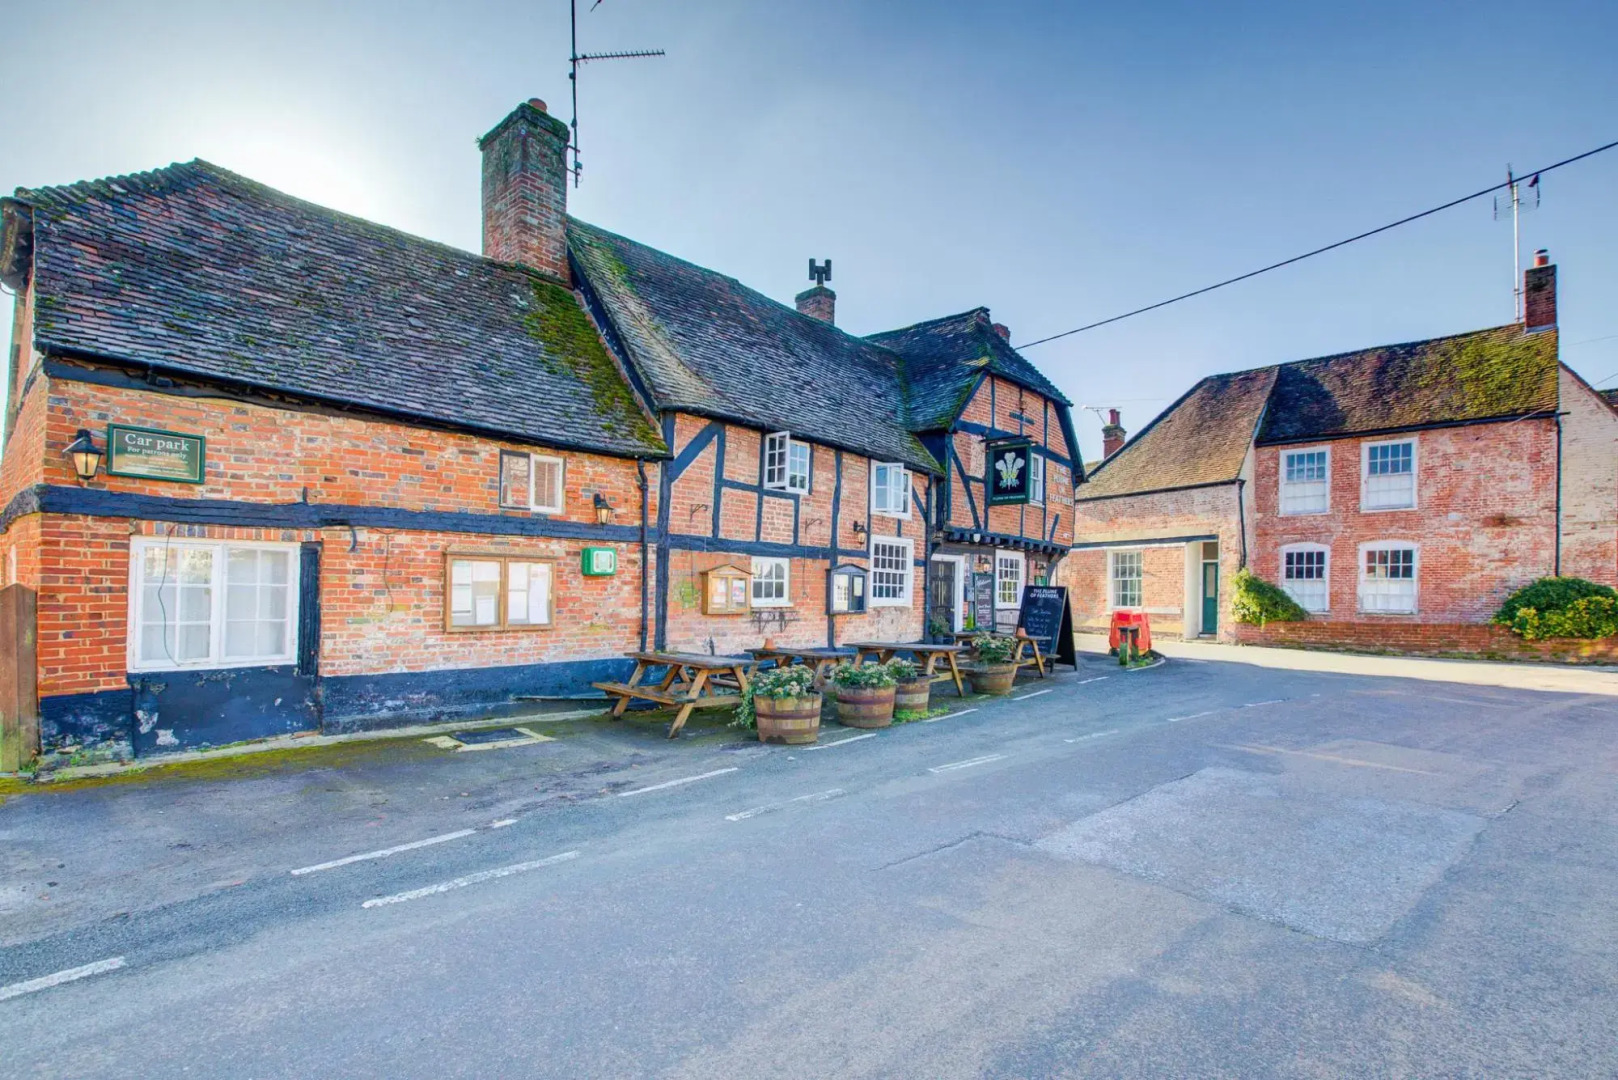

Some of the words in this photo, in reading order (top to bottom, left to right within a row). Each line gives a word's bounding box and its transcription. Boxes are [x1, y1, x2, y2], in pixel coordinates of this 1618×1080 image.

[124, 434, 152, 446] Car
[156, 439, 190, 452] park
[142, 448, 170, 456] patrons
[171, 452, 187, 460] only
